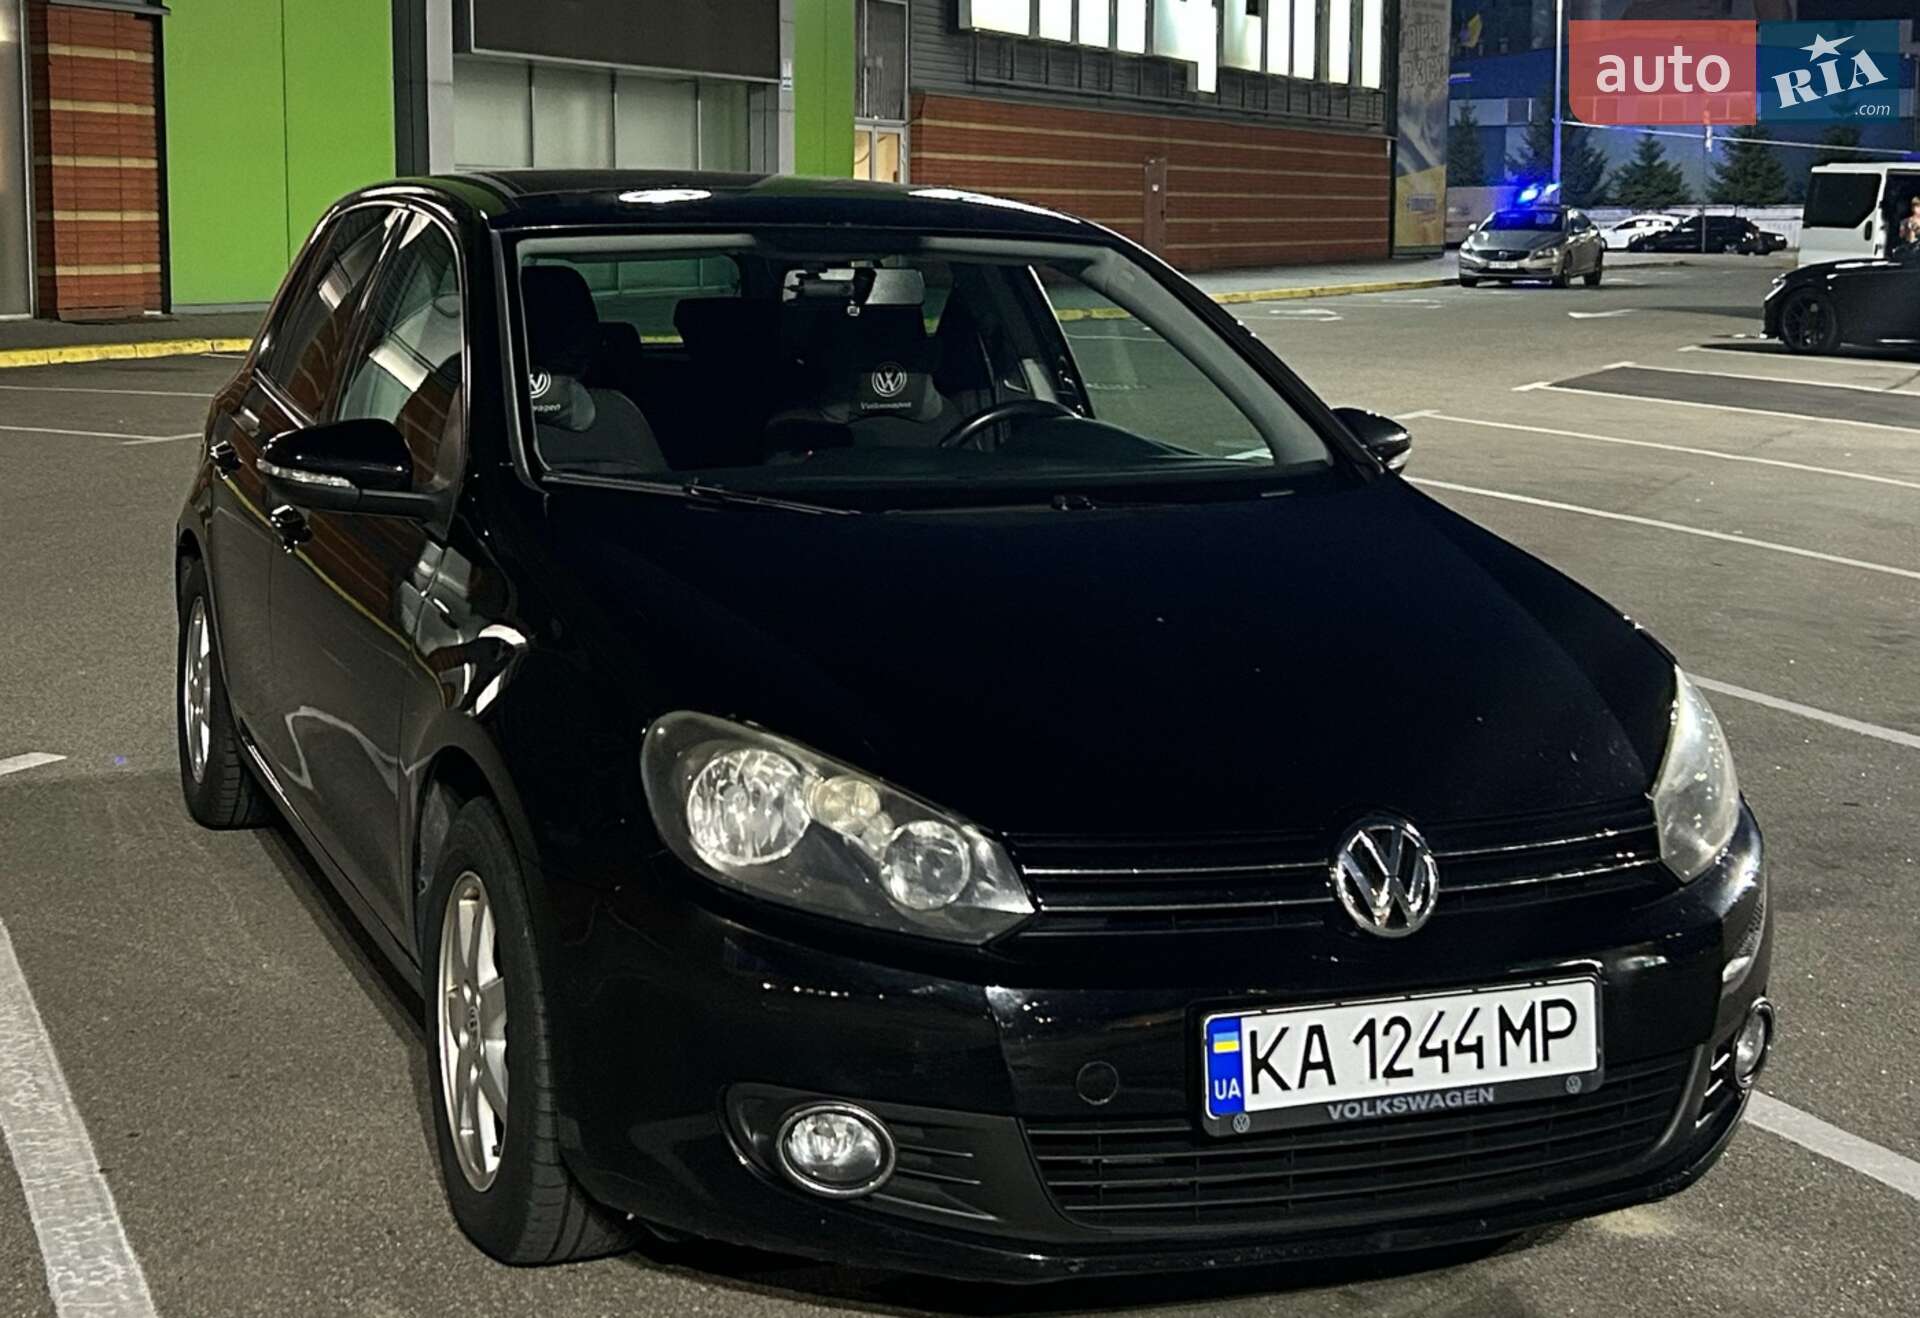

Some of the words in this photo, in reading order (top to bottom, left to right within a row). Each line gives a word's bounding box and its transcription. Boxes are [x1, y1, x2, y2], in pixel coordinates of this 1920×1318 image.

[1249, 1024, 1337, 1095] KA
[1352, 1007, 1485, 1080] 1244
[1497, 998, 1578, 1067] MP
[1214, 1077, 1241, 1100] UA
[1327, 1088, 1495, 1120] VOLKSWAGEN
